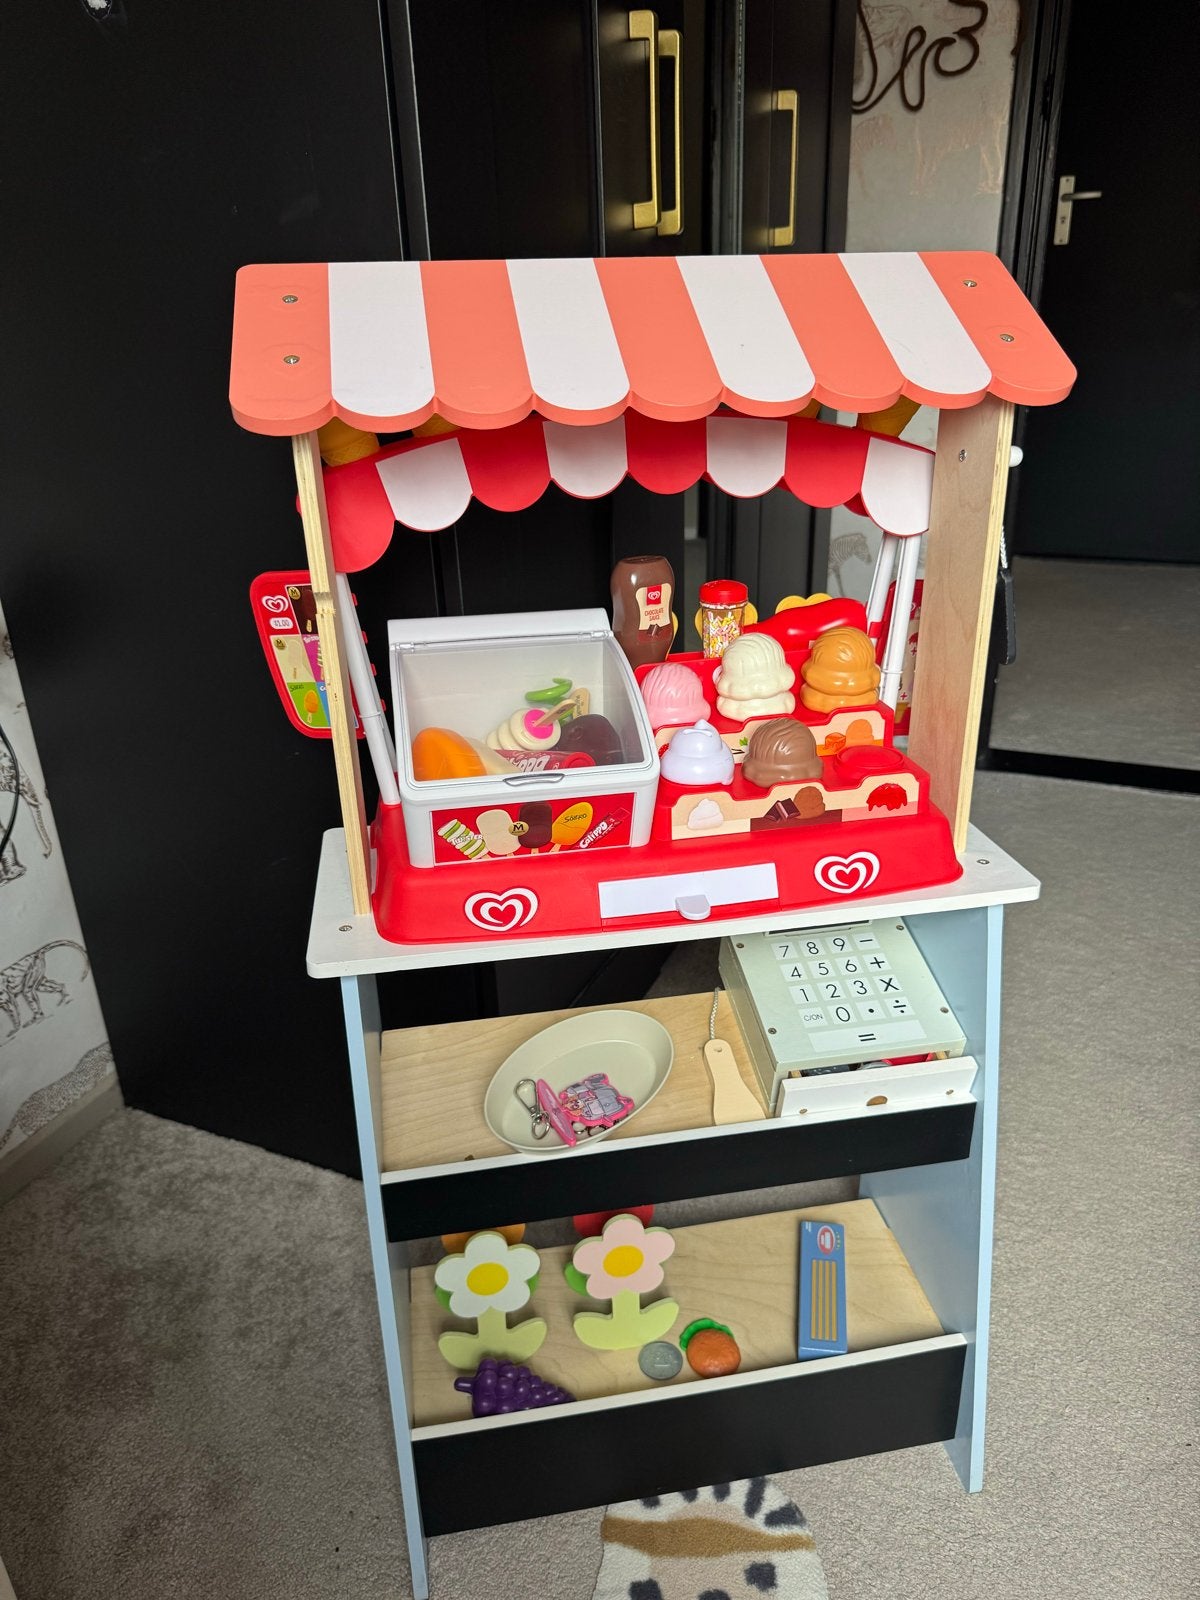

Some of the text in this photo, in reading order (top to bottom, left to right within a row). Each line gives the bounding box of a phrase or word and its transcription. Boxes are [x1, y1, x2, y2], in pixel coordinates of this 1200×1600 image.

[644, 607, 664, 616] CHOCOLATE
[778, 945, 789, 958] 7
[806, 941, 819, 954] 8
[833, 937, 846, 951] 9
[791, 966, 802, 978] 4
[818, 962, 829, 975] 5
[845, 959, 857, 972] 6
[799, 988, 809, 1002] 1
[825, 983, 840, 998] 2
[853, 980, 867, 994] 3
[803, 1013, 823, 1022] C/ON
[835, 1006, 850, 1022] 0
